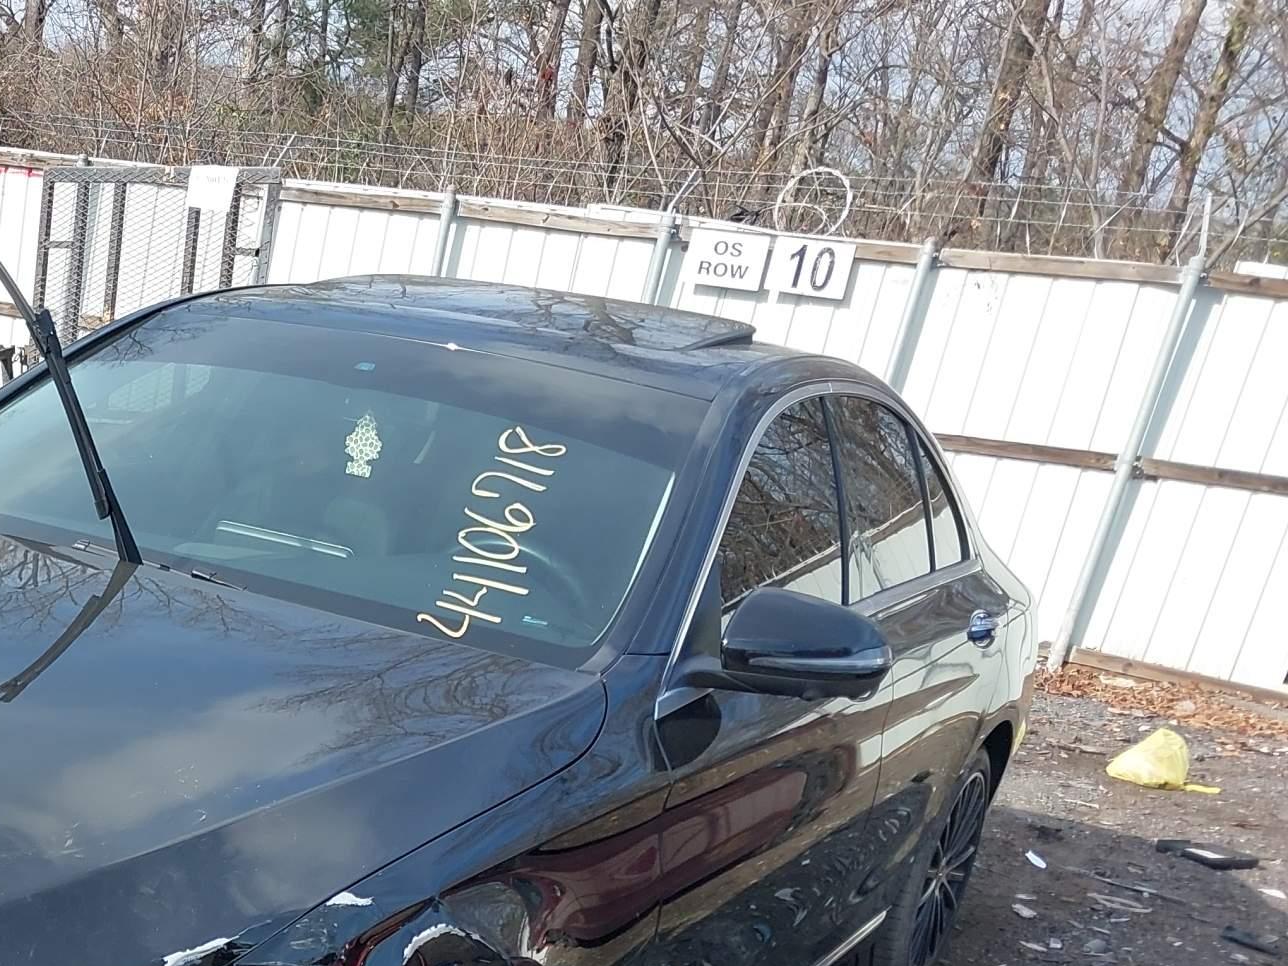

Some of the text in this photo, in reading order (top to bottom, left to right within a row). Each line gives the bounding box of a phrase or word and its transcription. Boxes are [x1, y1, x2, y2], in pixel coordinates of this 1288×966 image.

[713, 240, 743, 257] OS
[697, 260, 749, 279] ROW
[789, 243, 836, 291] 10
[416, 425, 567, 639] 44106718
